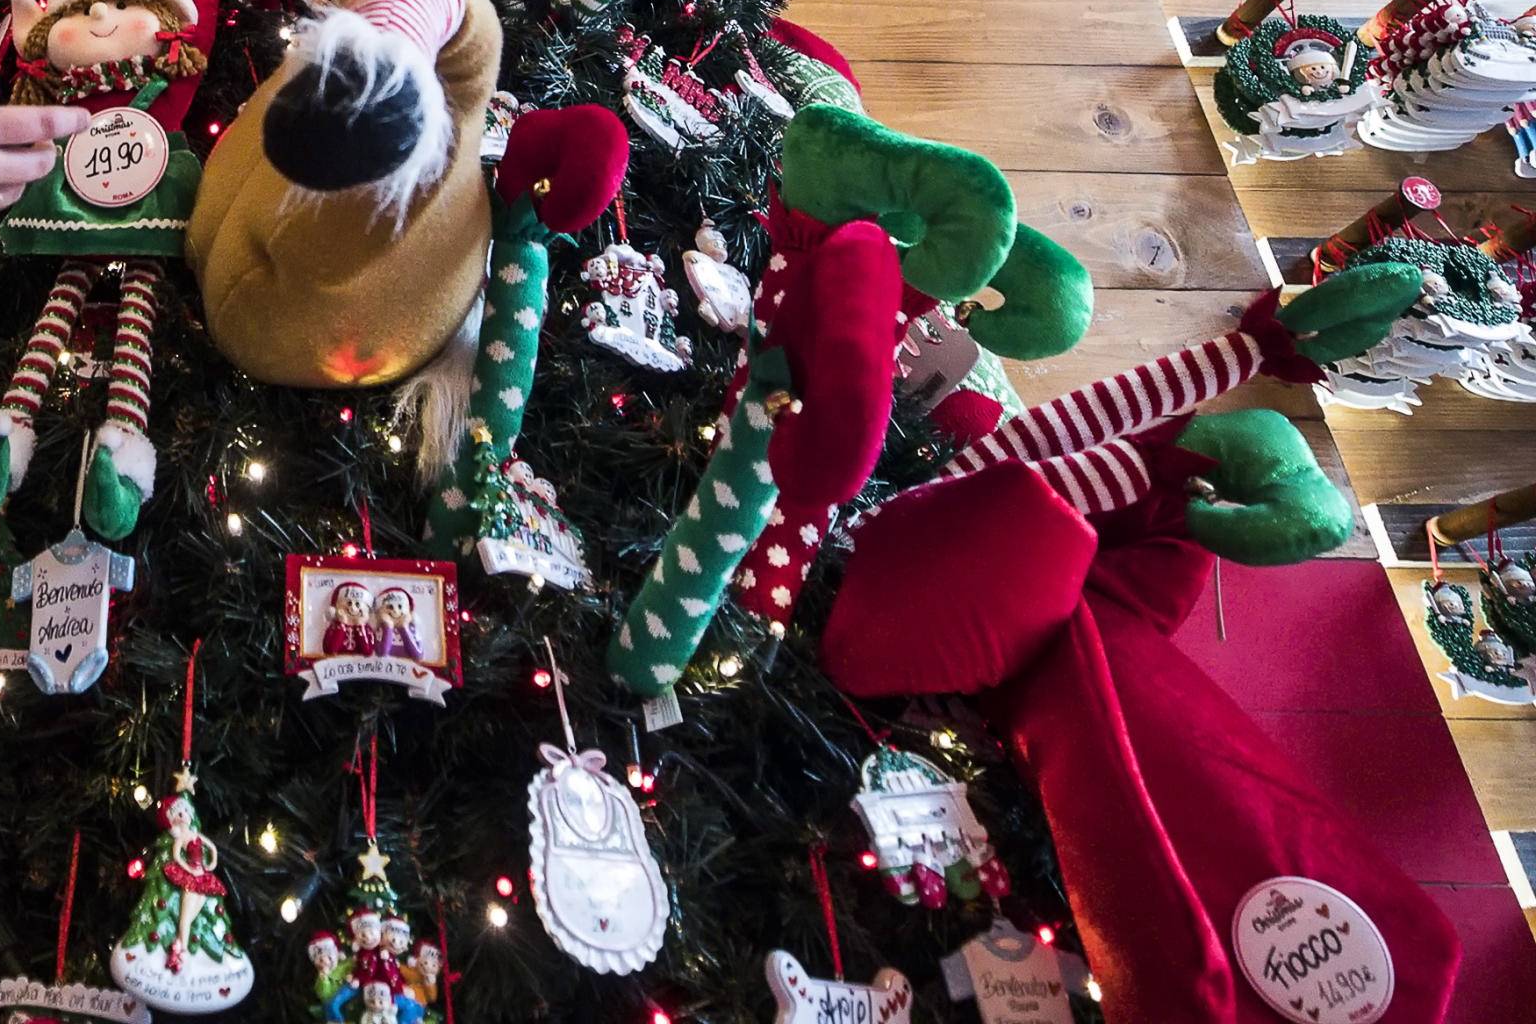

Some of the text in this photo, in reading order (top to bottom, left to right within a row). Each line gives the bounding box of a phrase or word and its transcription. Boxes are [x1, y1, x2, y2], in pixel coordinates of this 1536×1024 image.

[90, 121, 134, 137] Christmas
[84, 141, 144, 178] 19.90
[35, 578, 104, 609] Benvenuto
[38, 616, 94, 645] Andrea
[1263, 928, 1343, 990] Fiocco
